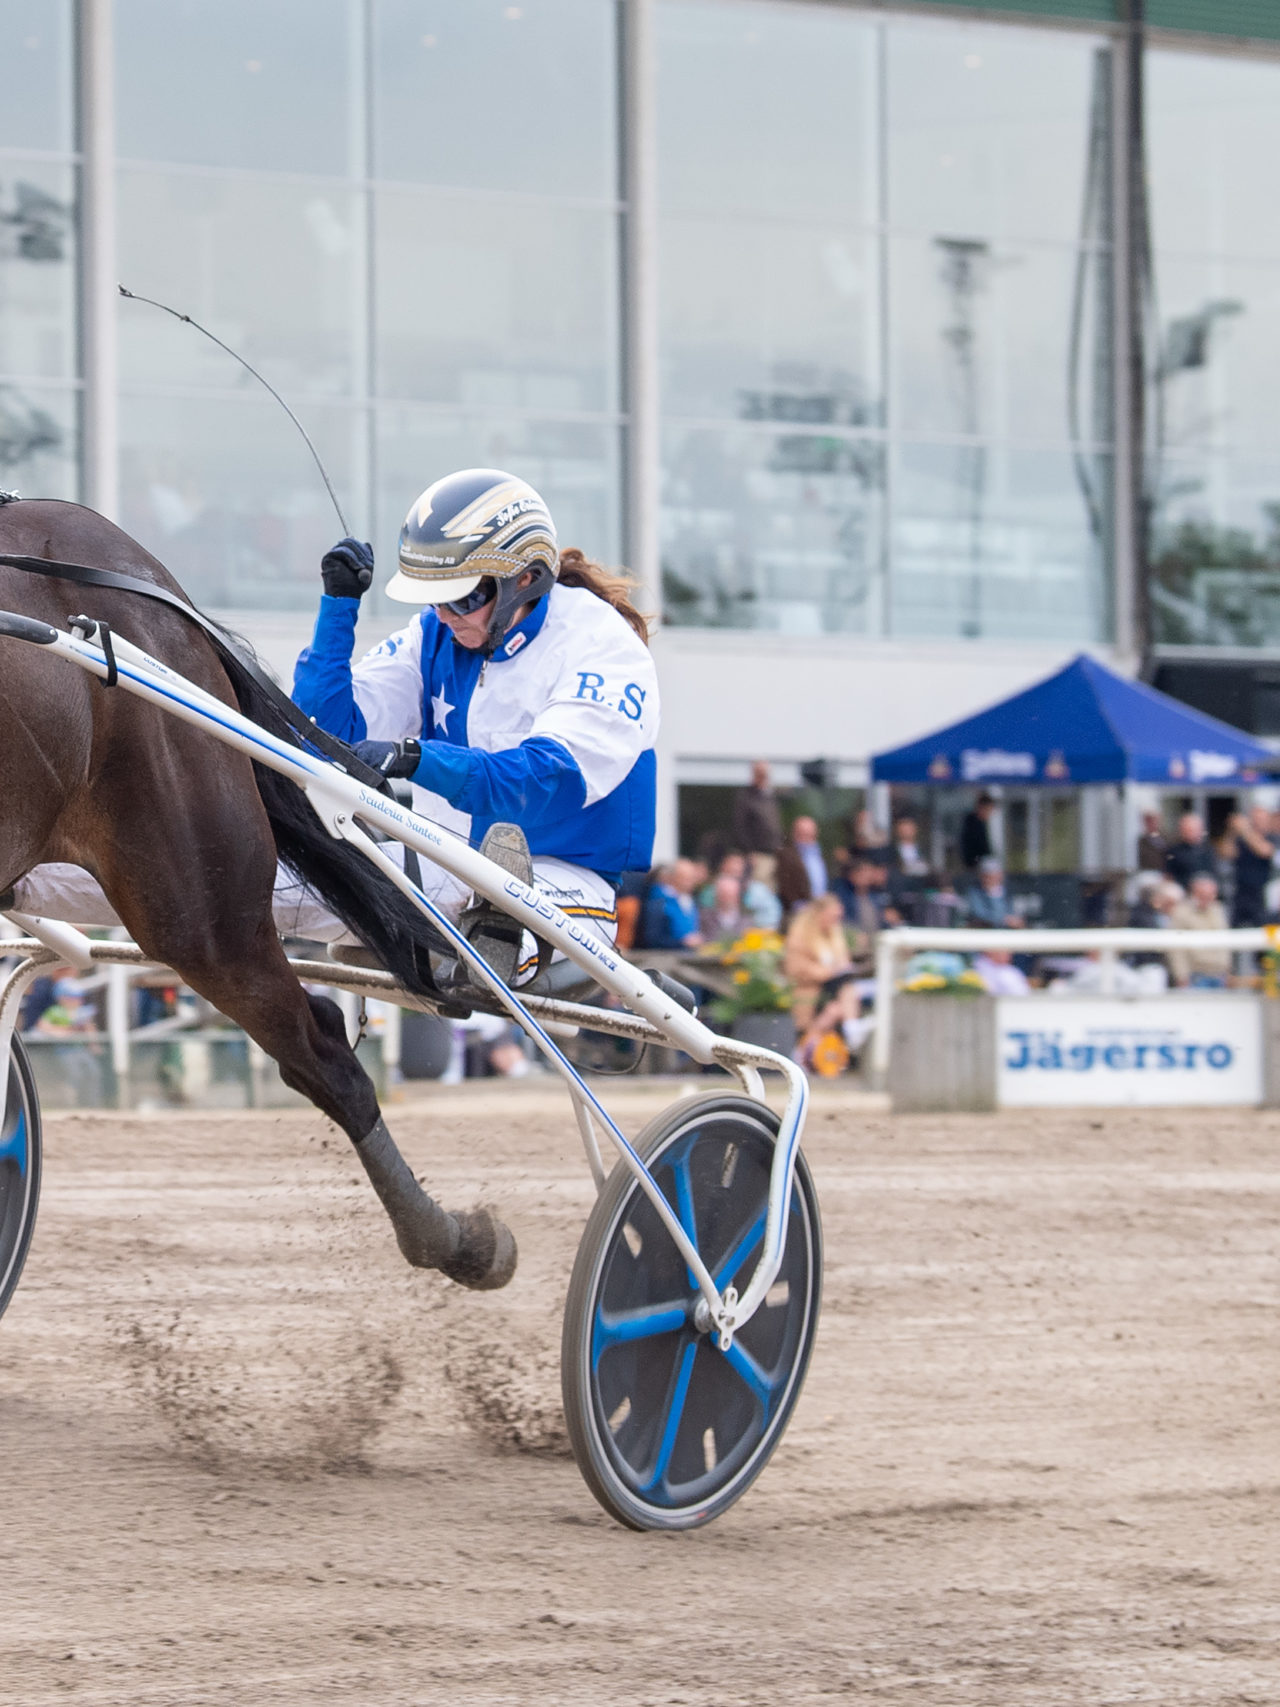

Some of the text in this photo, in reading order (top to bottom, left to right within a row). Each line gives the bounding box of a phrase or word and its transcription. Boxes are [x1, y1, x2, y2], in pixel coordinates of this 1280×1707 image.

[359, 787, 443, 846] Scuderia Santese
[503, 878, 600, 956] CUSTOM
[1005, 1029, 1234, 1072] Jägersro
